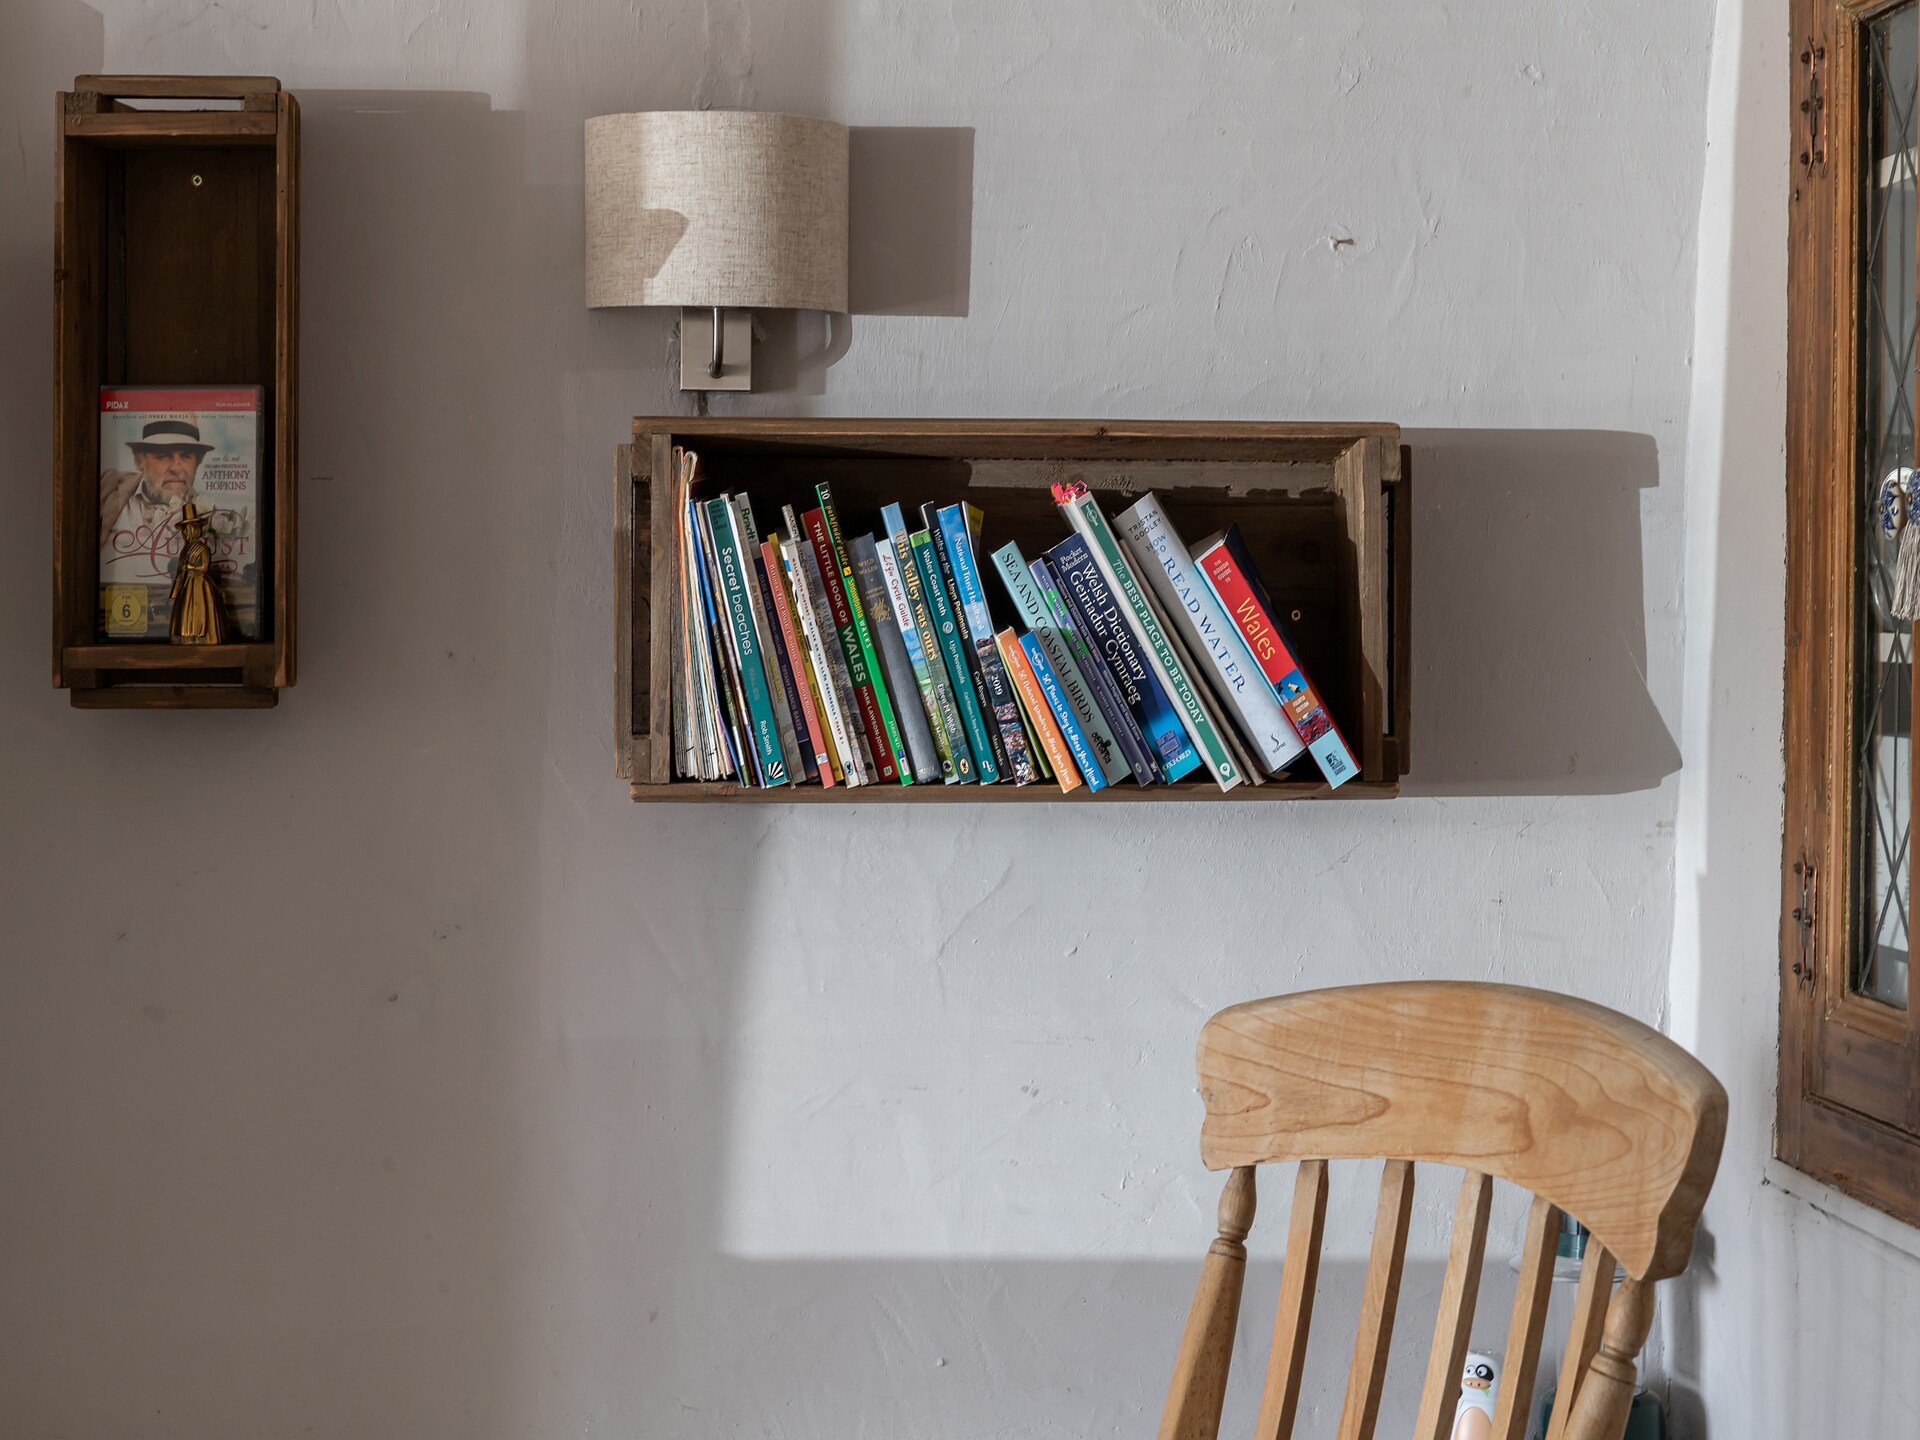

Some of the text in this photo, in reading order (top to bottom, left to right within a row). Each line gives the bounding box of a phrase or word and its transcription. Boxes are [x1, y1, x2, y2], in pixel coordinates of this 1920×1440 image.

[106, 401, 129, 409] PIDAX
[202, 470, 251, 479] ANTHONY
[205, 481, 247, 491] HOPKINS
[820, 489, 831, 500] 10
[741, 508, 755, 540] Bradt
[813, 522, 823, 542] THE
[1128, 509, 1158, 534] TRISTAN
[1134, 518, 1162, 541] GOOLEY
[933, 529, 944, 551] Walks
[1145, 532, 1167, 552] HOW
[1153, 544, 1167, 557] TO
[819, 544, 833, 576] LITTLE
[837, 545, 847, 566] guide
[939, 552, 946, 561] on
[942, 561, 951, 574] the
[1060, 547, 1082, 564] Pocket
[1062, 553, 1088, 573] Modern
[1213, 561, 1230, 576] ROUGH
[922, 549, 946, 616] Wales Coast Path
[954, 538, 983, 631] National Trust Handbook
[1217, 568, 1233, 581] GUIDE
[723, 547, 738, 591] Secret
[733, 594, 752, 655] beaches
[830, 580, 842, 608] BOOK
[848, 578, 862, 618] Snowdonia
[890, 578, 901, 601] Cycle
[898, 603, 909, 627] Guide
[895, 530, 936, 661] This Valley was ours
[122, 604, 131, 618] 6
[838, 609, 848, 624] OF
[954, 601, 968, 639] Peninsula
[1081, 562, 1146, 683] Welsh Dictionary
[1164, 556, 1249, 694] READ WATER
[859, 620, 870, 648] WALES
[1002, 552, 1093, 723] SEA AND COASTAL BIRDS
[1069, 569, 1141, 705] Geiriadur Cymraeg
[1112, 558, 1202, 724] The BEST PLACE TO BE TODAY
[1236, 596, 1276, 661] Wales
[842, 625, 864, 682] WALES
[953, 654, 965, 683] Peninsula
[972, 671, 981, 685] Carl
[990, 674, 1002, 695] 2019
[861, 687, 884, 757] MARK LAWSON-JONES
[930, 712, 939, 725] Phil
[937, 683, 947, 704] Eileen
[946, 715, 956, 733] Webb
[759, 720, 771, 755] Rob Smith
[1018, 669, 1027, 680] 50
[1054, 753, 1064, 767] Your
[1061, 768, 1072, 785] Mind
[1042, 674, 1050, 685] 50
[1047, 685, 1060, 705] Places
[1057, 711, 1070, 729] Stay
[1070, 734, 1081, 751] Blow
[1077, 751, 1089, 767] Your
[1086, 767, 1098, 786] Mind
[1163, 749, 1191, 770] OXFORD
